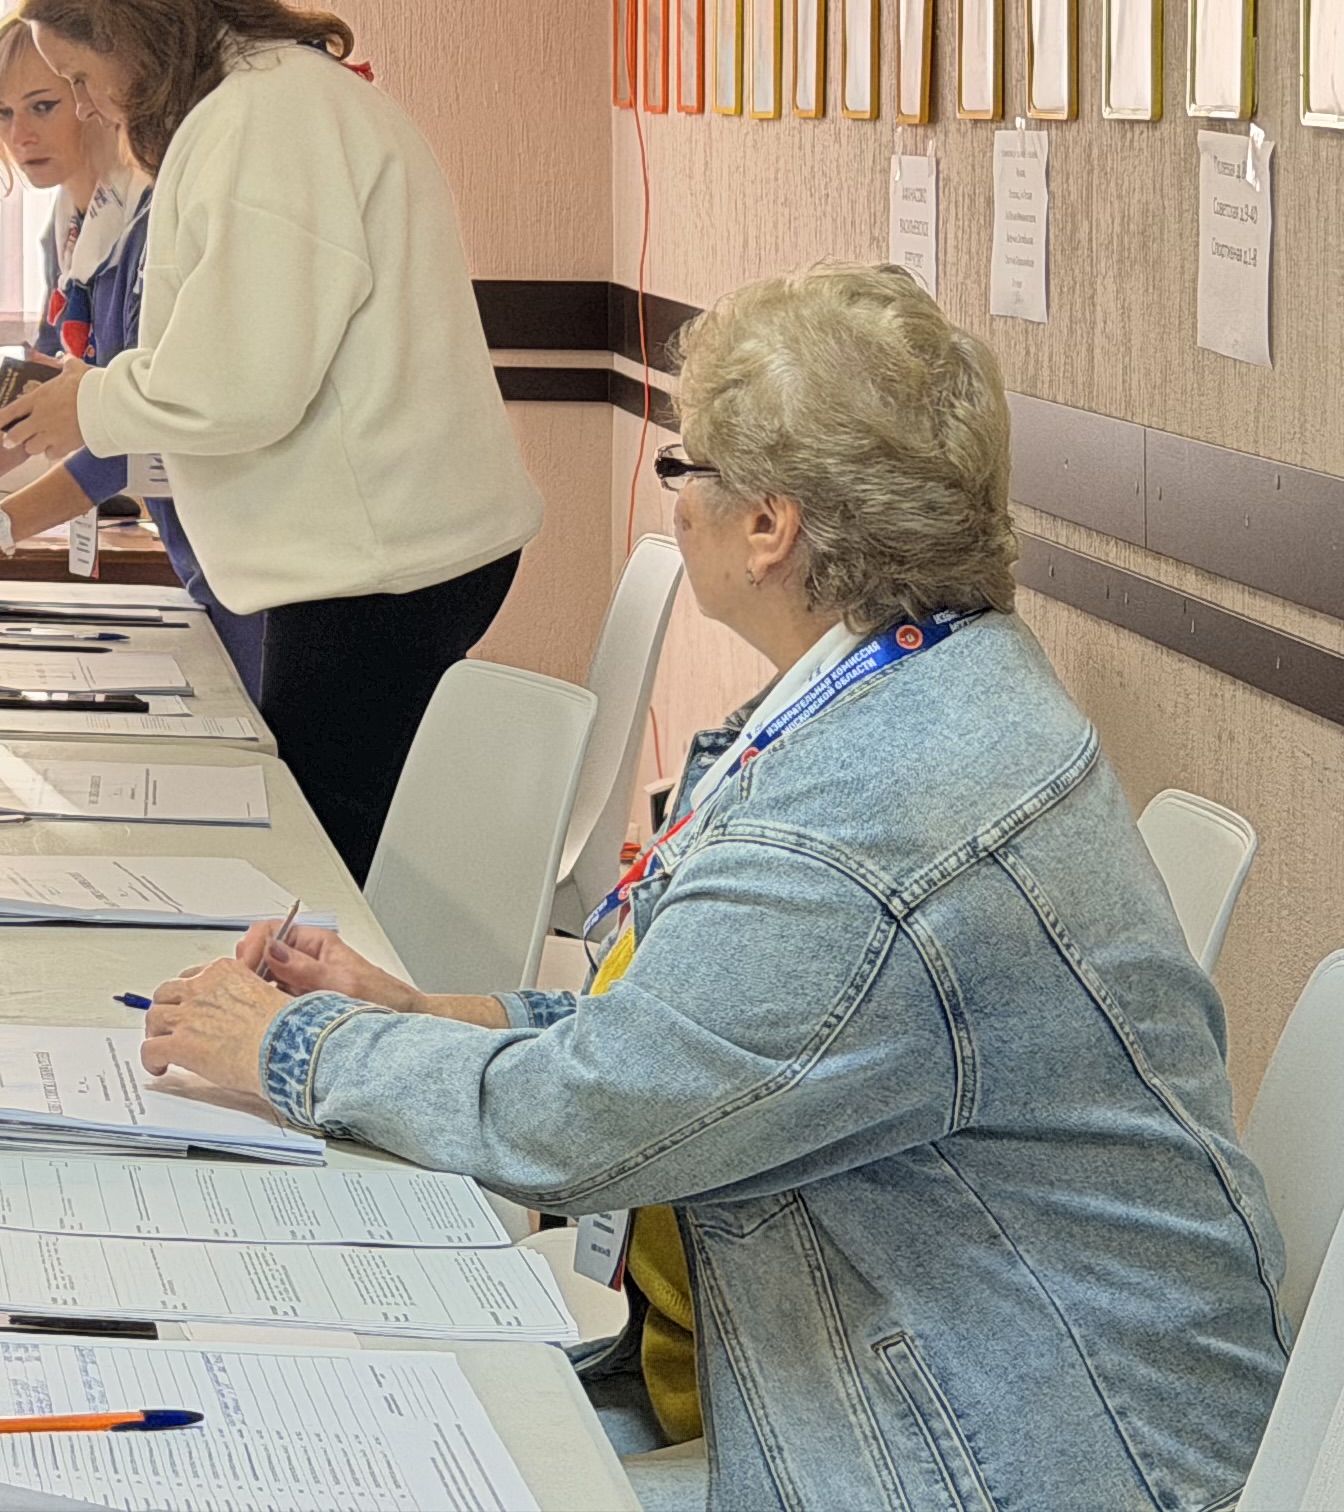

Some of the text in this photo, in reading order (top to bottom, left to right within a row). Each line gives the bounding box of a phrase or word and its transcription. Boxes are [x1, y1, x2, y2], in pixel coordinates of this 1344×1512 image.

[765, 640, 882, 738] ИЗБИРАТЕЛЬНАЯ КОМИССИЯ
[780, 657, 878, 737] МОСКОВСКОЙ ОБЛАСТИ
